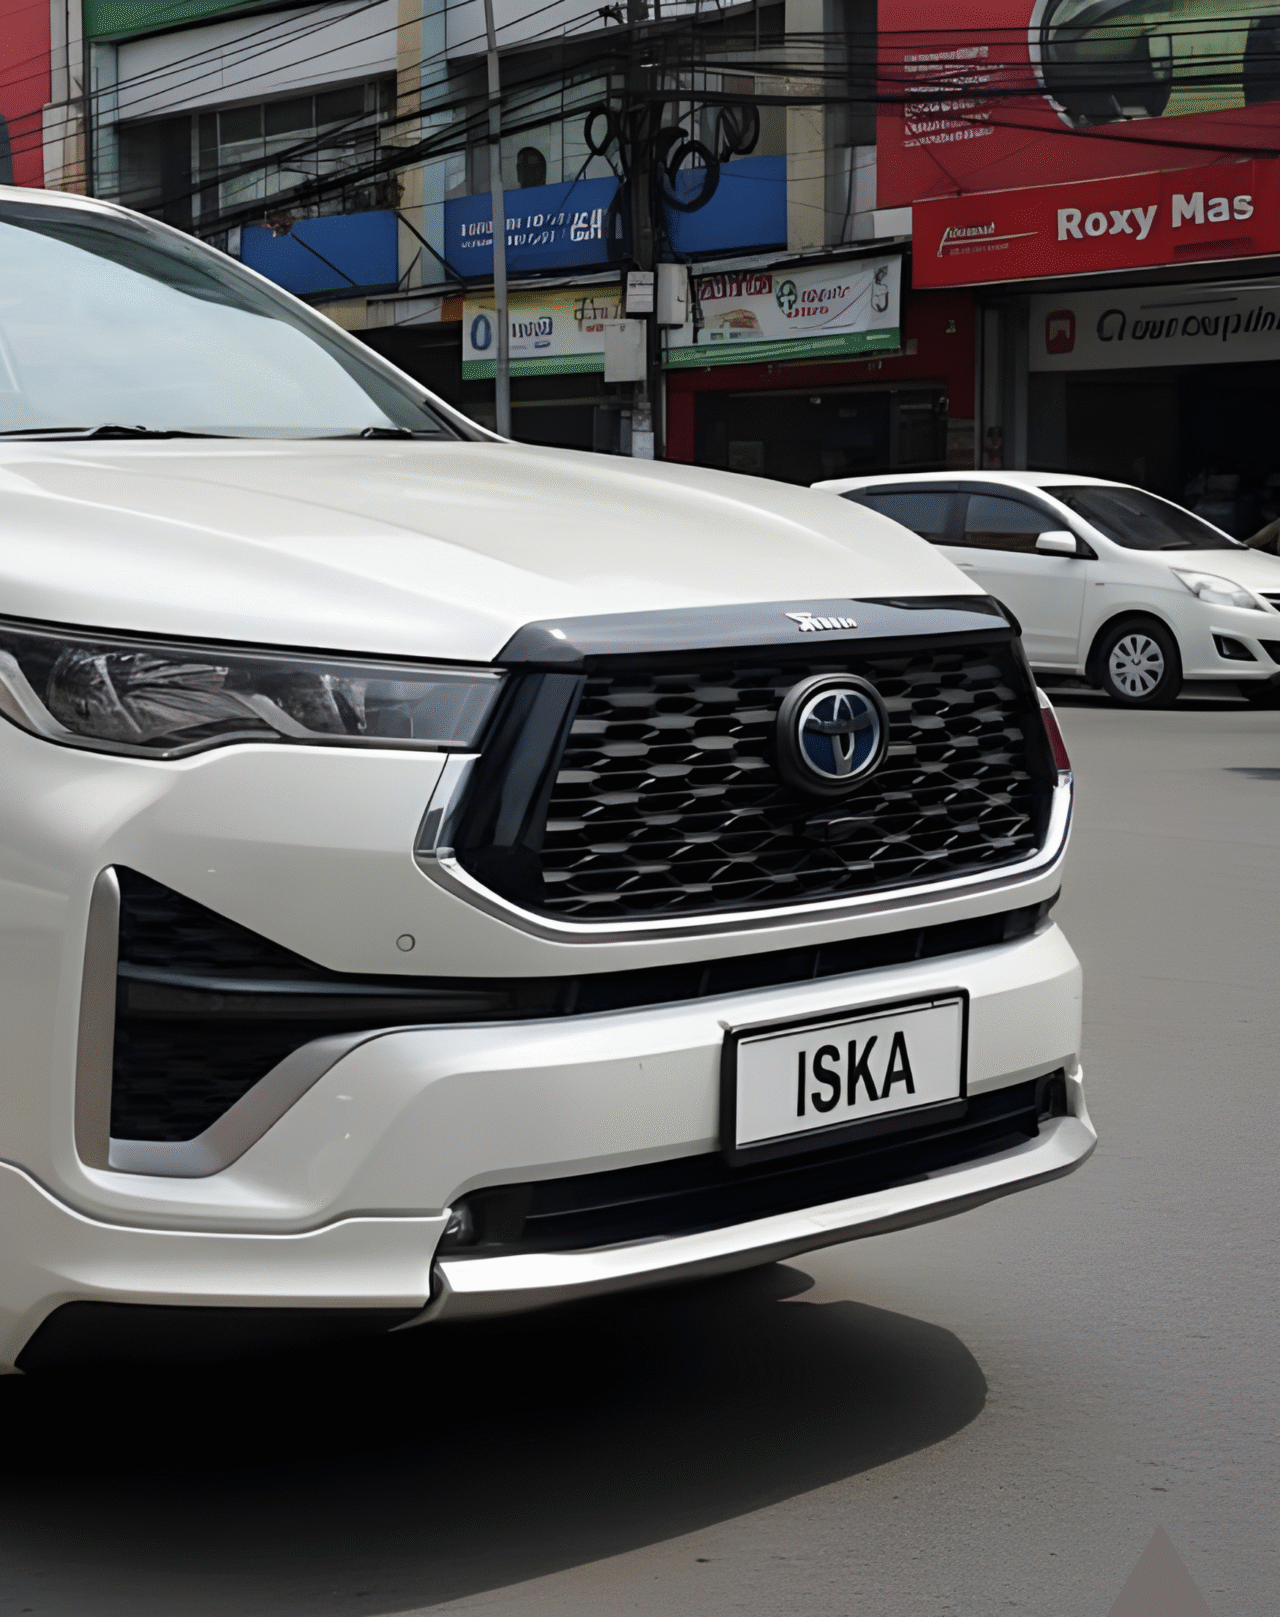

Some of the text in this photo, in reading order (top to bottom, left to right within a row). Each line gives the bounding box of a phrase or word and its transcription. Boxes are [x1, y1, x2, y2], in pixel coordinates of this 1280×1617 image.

[1056, 191, 1254, 241] Roxy Mas
[797, 1030, 916, 1117] ISKA
